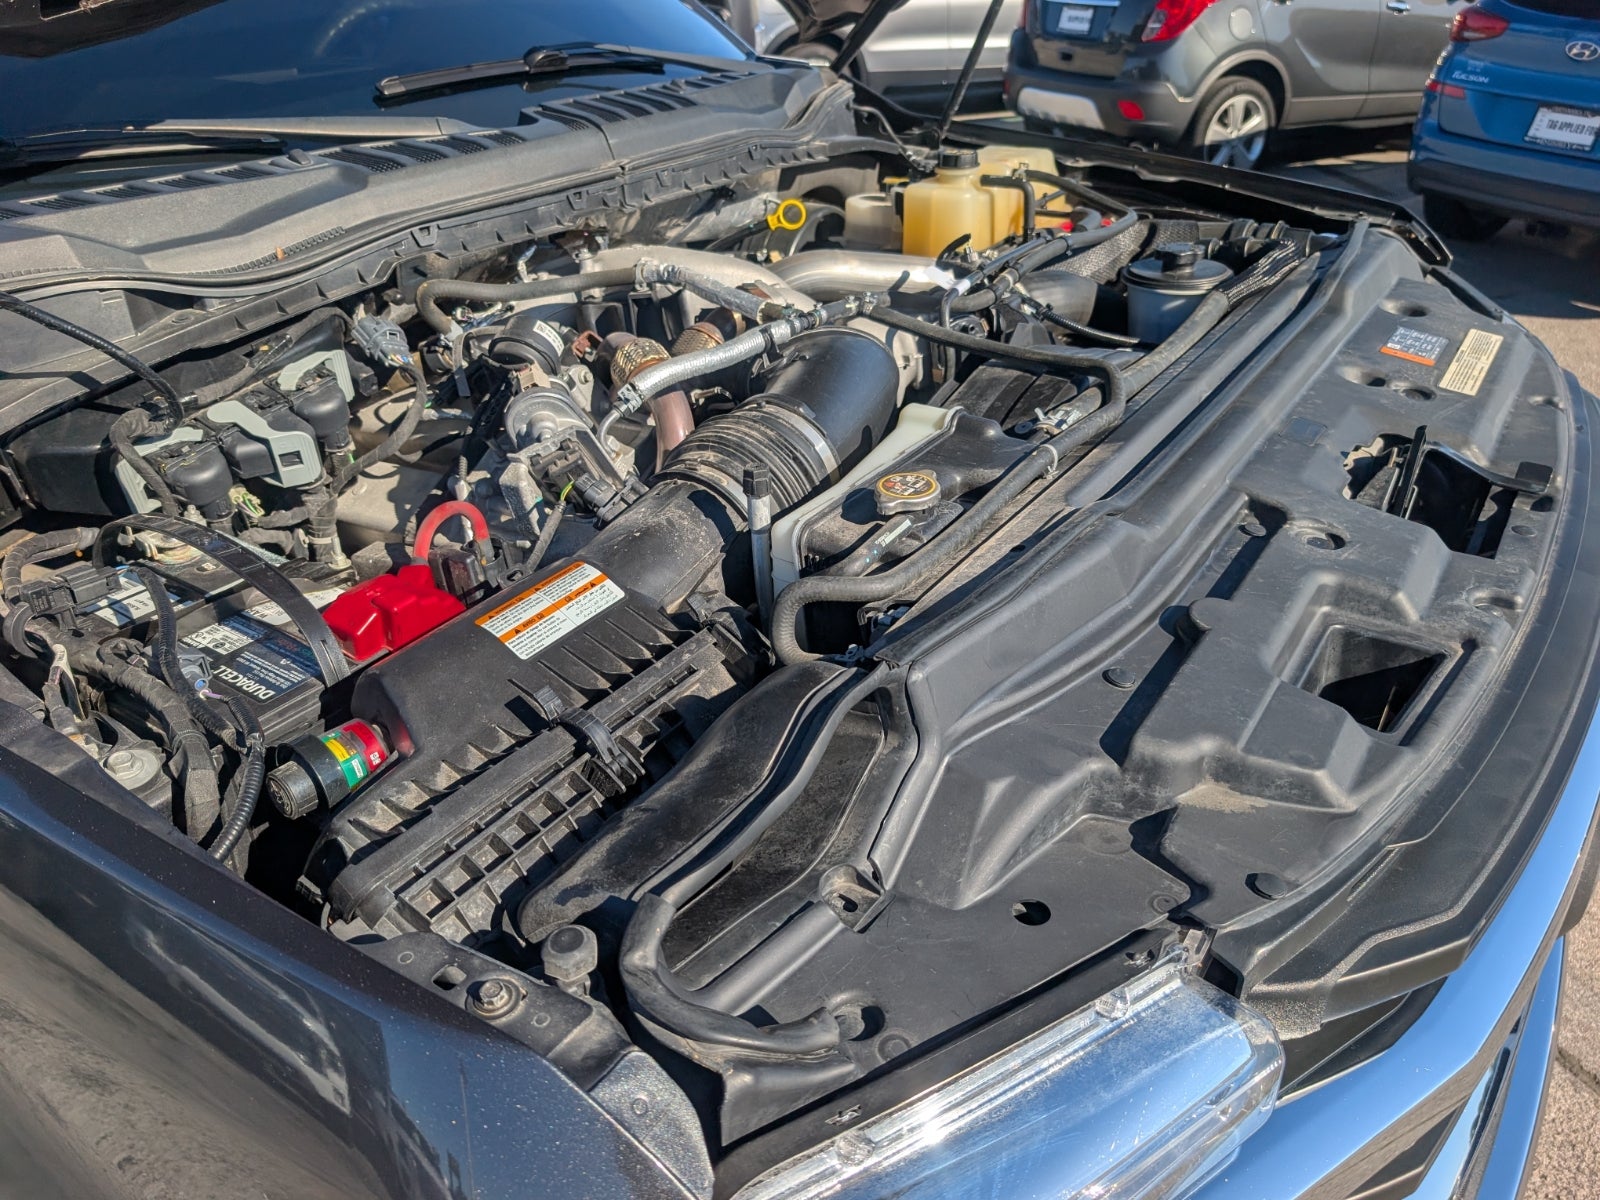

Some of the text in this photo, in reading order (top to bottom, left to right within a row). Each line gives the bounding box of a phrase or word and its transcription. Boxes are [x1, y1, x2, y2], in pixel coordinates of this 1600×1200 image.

[1452, 70, 1489, 83] TUCSON
[1559, 121, 1585, 135] APPLIED
[212, 665, 276, 700] DURACELL
